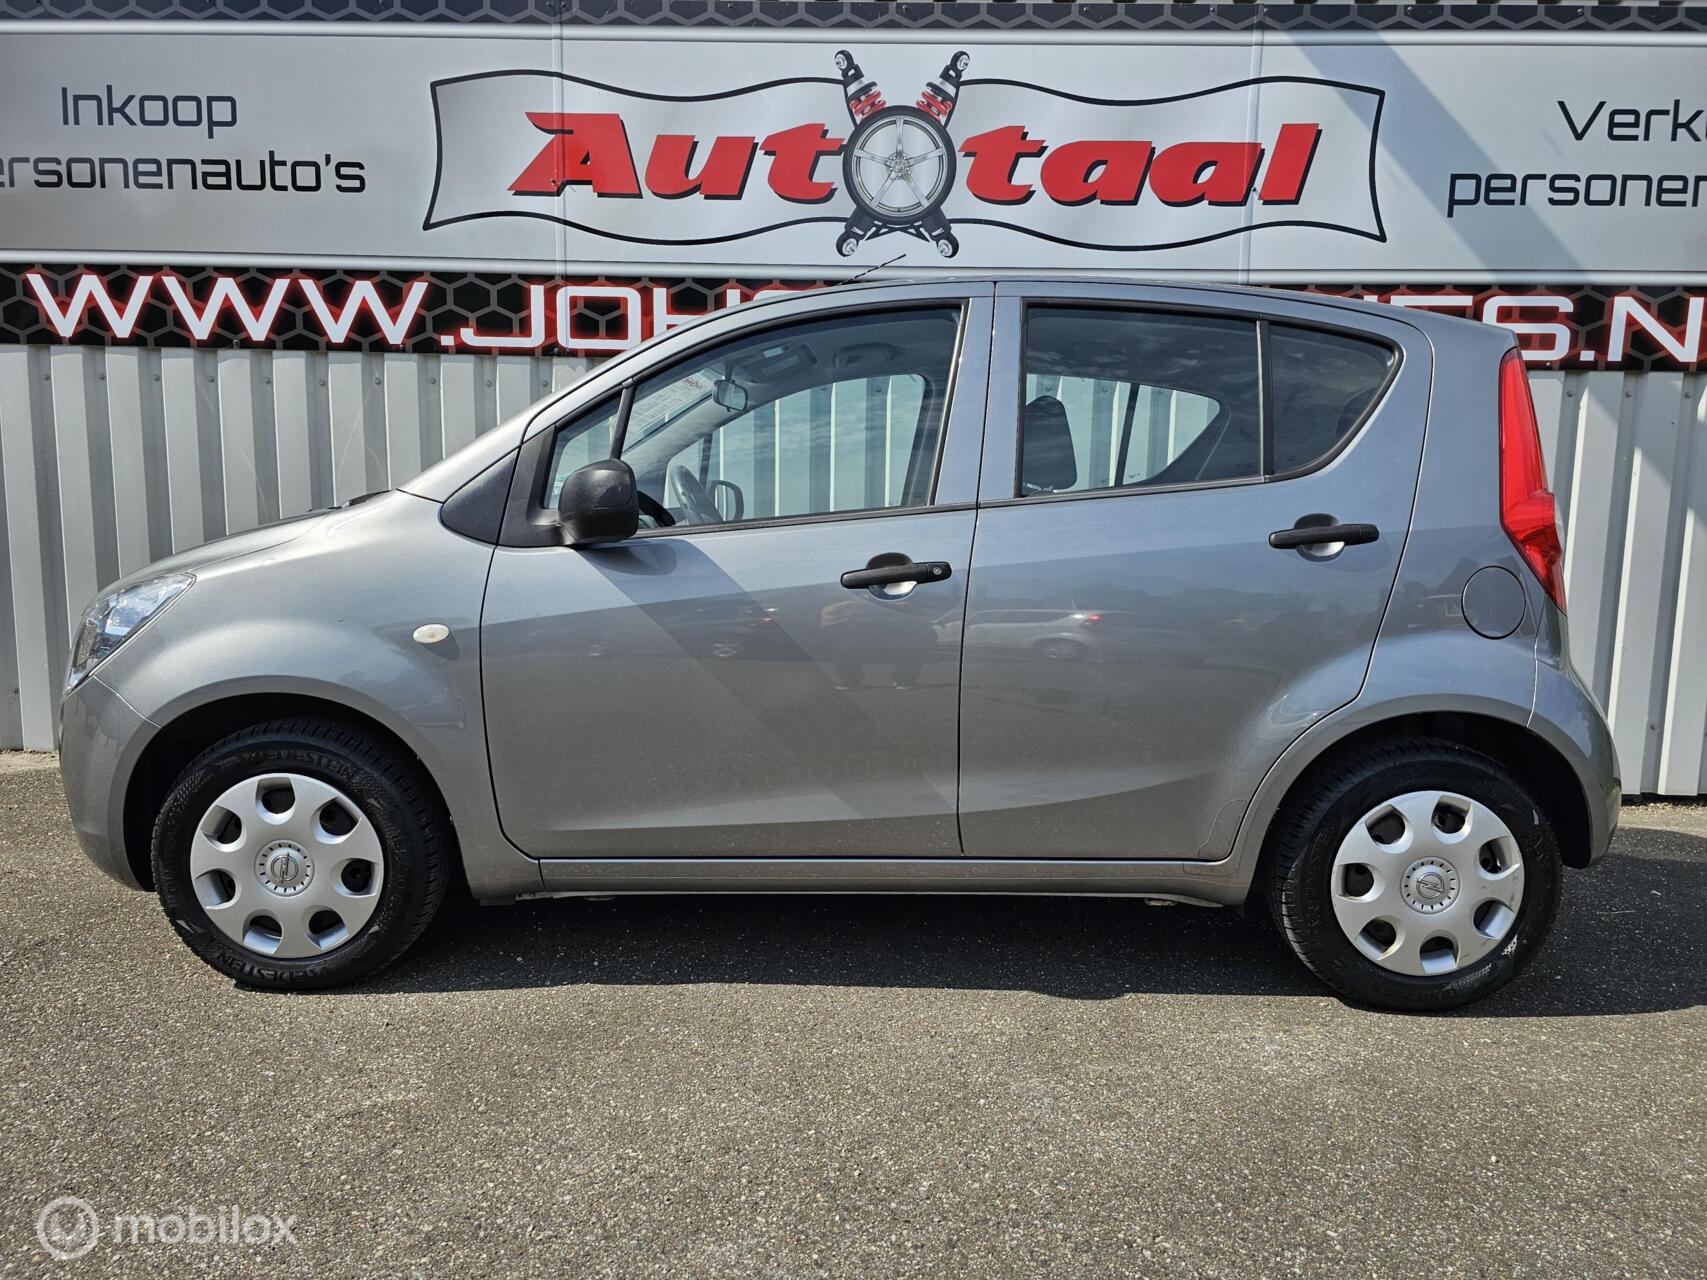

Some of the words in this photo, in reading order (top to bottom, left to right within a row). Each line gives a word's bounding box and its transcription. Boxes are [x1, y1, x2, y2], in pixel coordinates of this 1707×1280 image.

[61, 85, 237, 138] Inkoop
[1557, 99, 1707, 142] Verk
[0, 151, 366, 193] rsonenauto's
